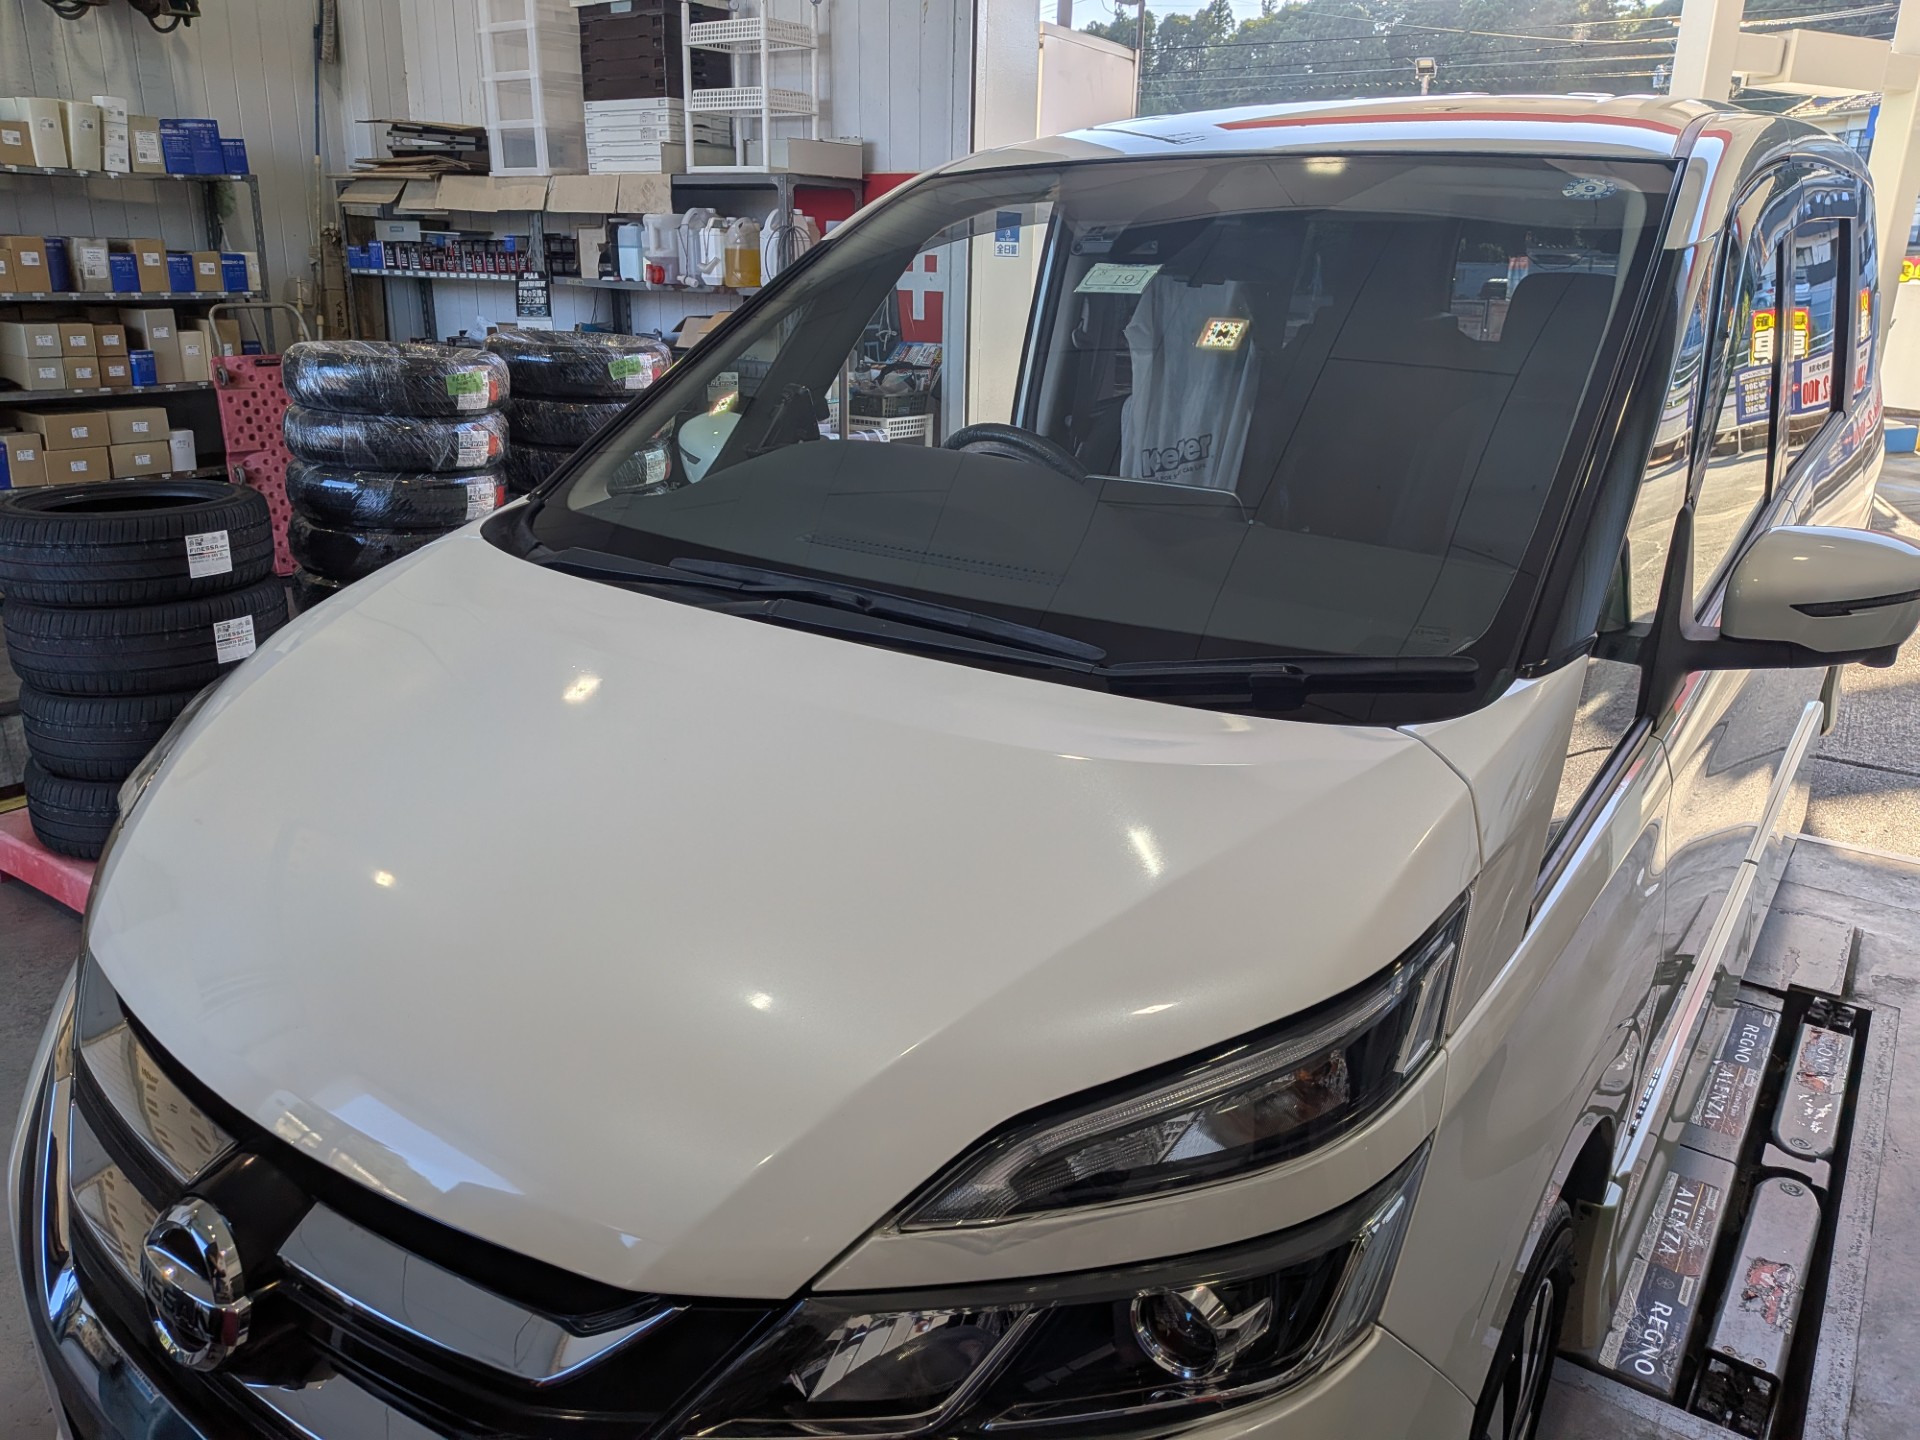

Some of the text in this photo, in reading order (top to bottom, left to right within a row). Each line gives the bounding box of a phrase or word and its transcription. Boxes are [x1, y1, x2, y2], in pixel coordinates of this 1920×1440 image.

[523, 272, 539, 280] PIAA
[1734, 1023, 1760, 1064] REGNO
[1705, 1068, 1735, 1119] ALENZA
[1658, 1186, 1695, 1254] ALENZA
[140, 1256, 200, 1328] NISSAN
[1634, 1301, 1673, 1375] REGNO
